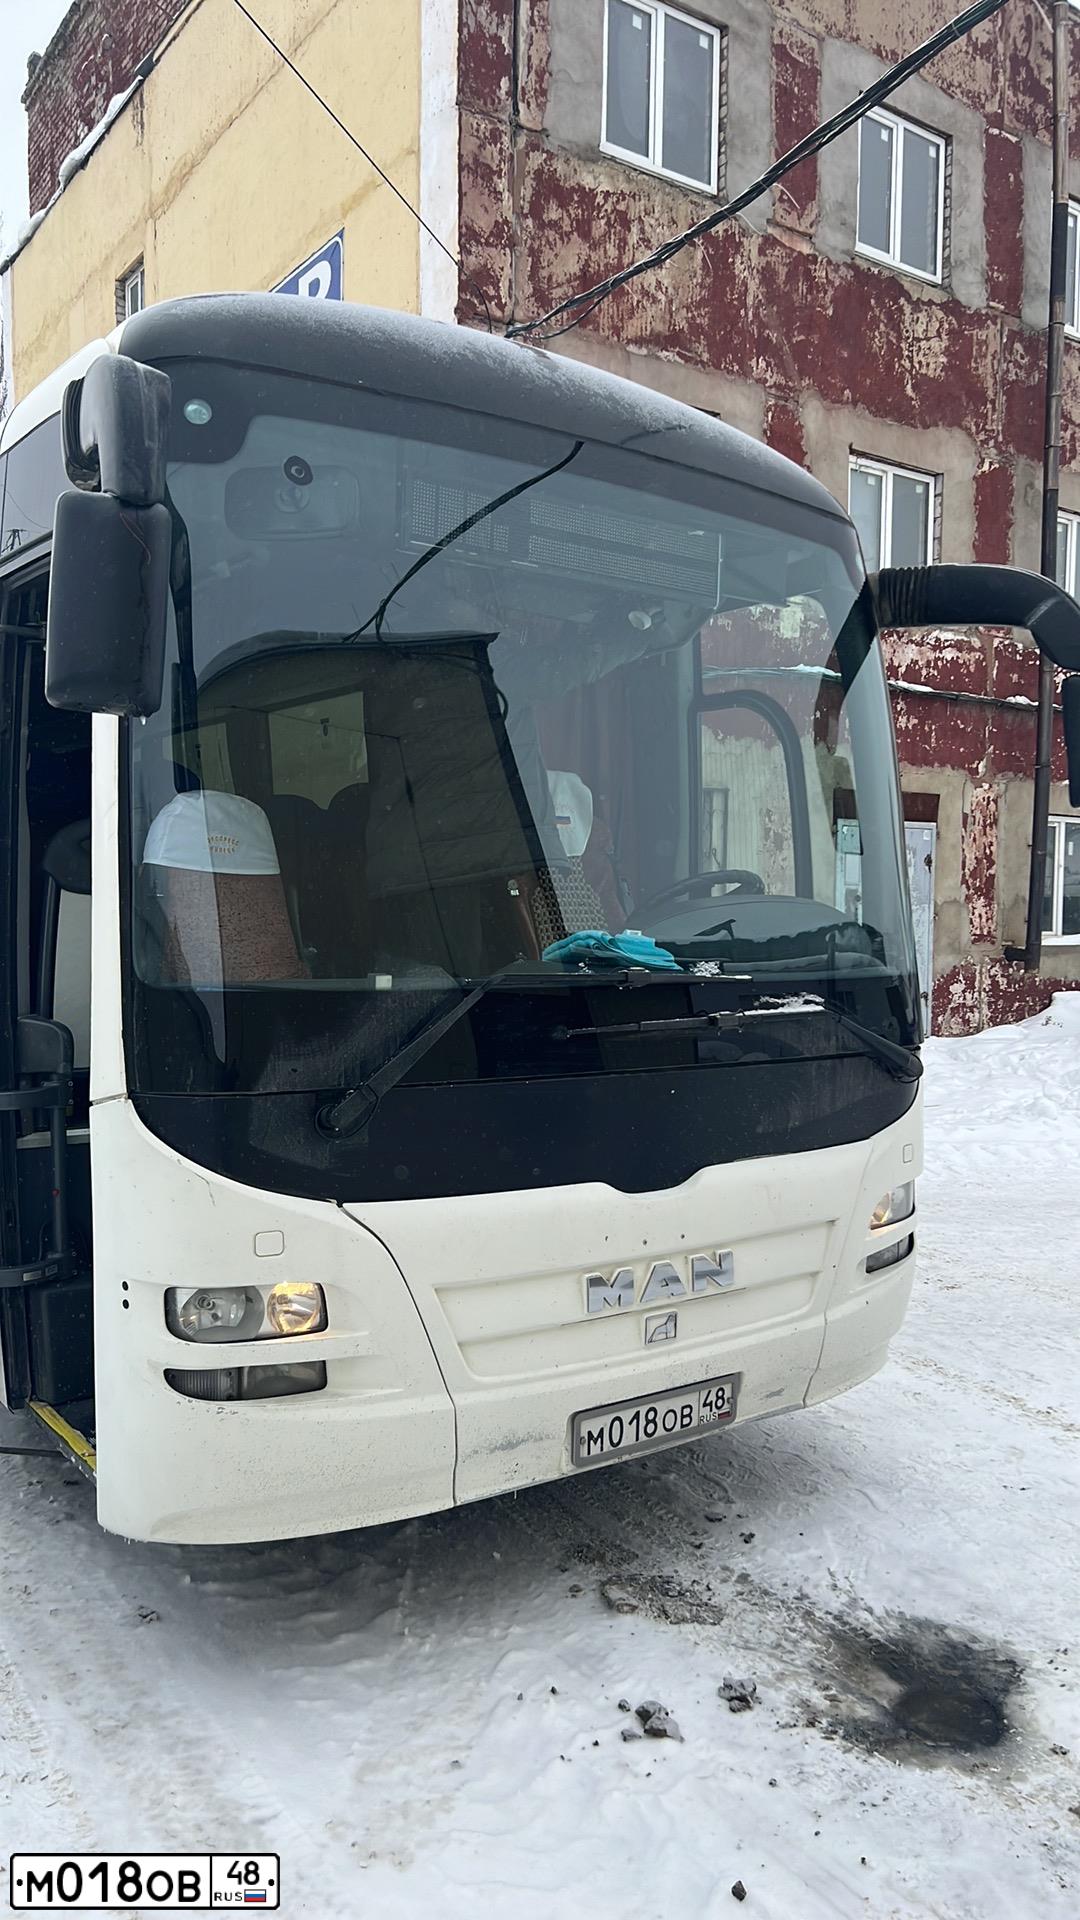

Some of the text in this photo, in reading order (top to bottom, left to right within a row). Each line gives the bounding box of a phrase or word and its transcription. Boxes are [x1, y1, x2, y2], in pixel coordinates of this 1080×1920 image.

[584, 1249, 734, 1314] MAN
[702, 1386, 726, 1413] 48
[699, 1412, 718, 1425] RUS
